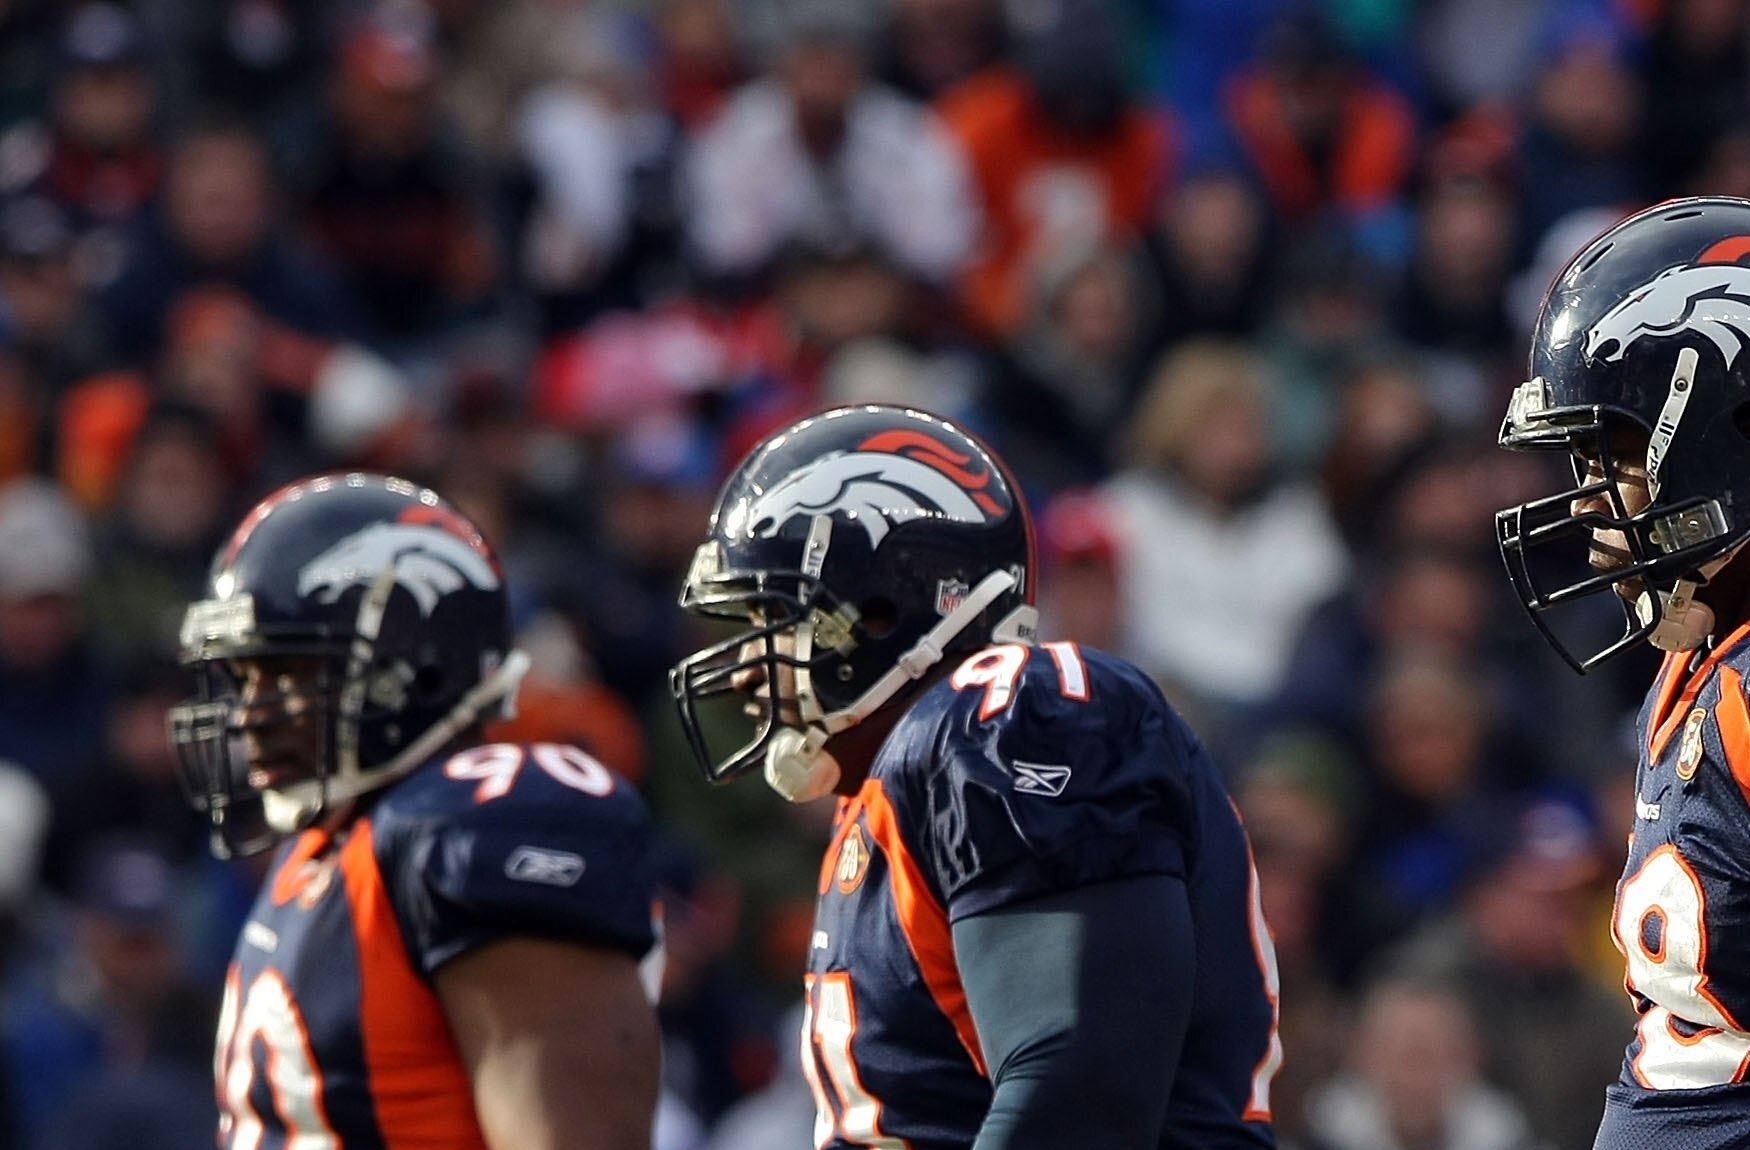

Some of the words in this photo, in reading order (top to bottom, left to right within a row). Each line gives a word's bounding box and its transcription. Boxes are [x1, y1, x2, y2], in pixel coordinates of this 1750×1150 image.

[1010, 563, 1025, 596] 91
[949, 639, 1093, 723] 91
[442, 741, 617, 807] 90
